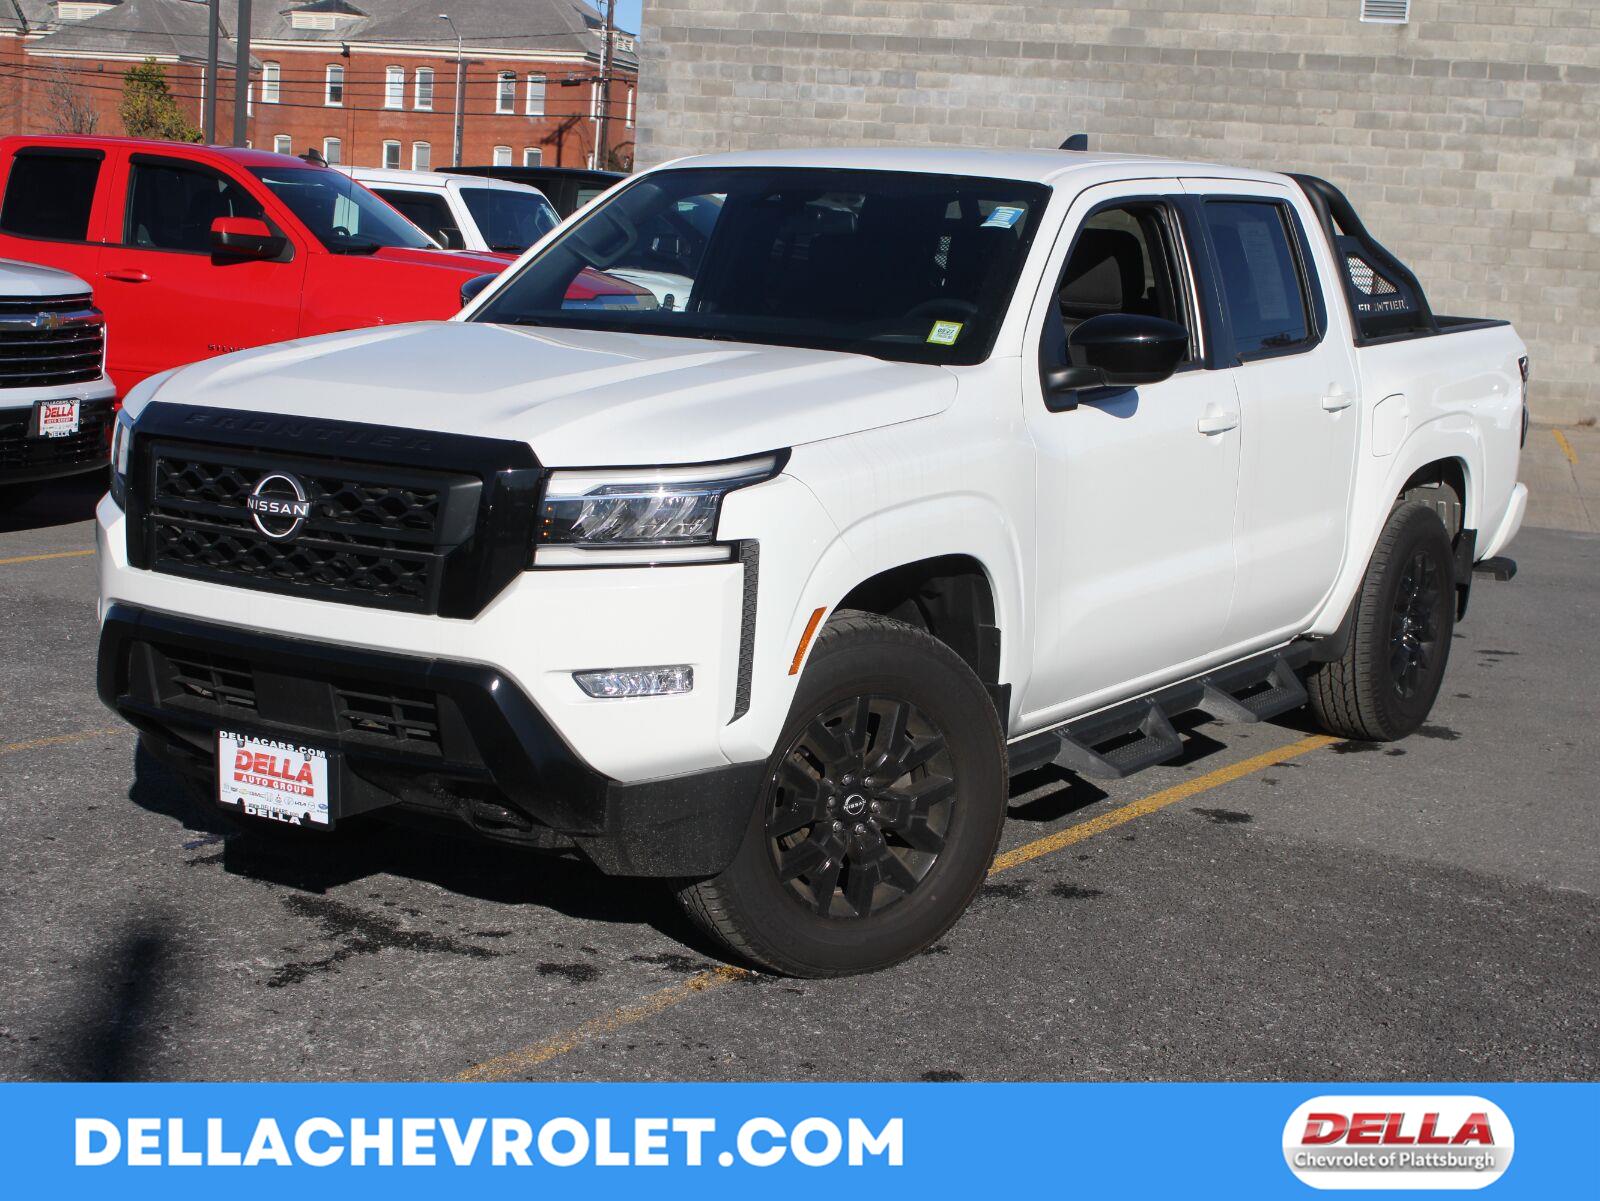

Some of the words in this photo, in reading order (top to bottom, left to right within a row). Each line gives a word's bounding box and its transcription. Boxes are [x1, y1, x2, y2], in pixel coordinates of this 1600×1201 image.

[44, 406, 73, 418] DELLA
[184, 412, 433, 451] FRONTIER
[247, 498, 307, 516] NISSAN
[220, 731, 326, 759] DELLACARS.COM
[235, 749, 313, 785] DELLA
[241, 774, 269, 786] AUTO
[272, 781, 307, 794] GROUP
[244, 806, 301, 825] DELLA
